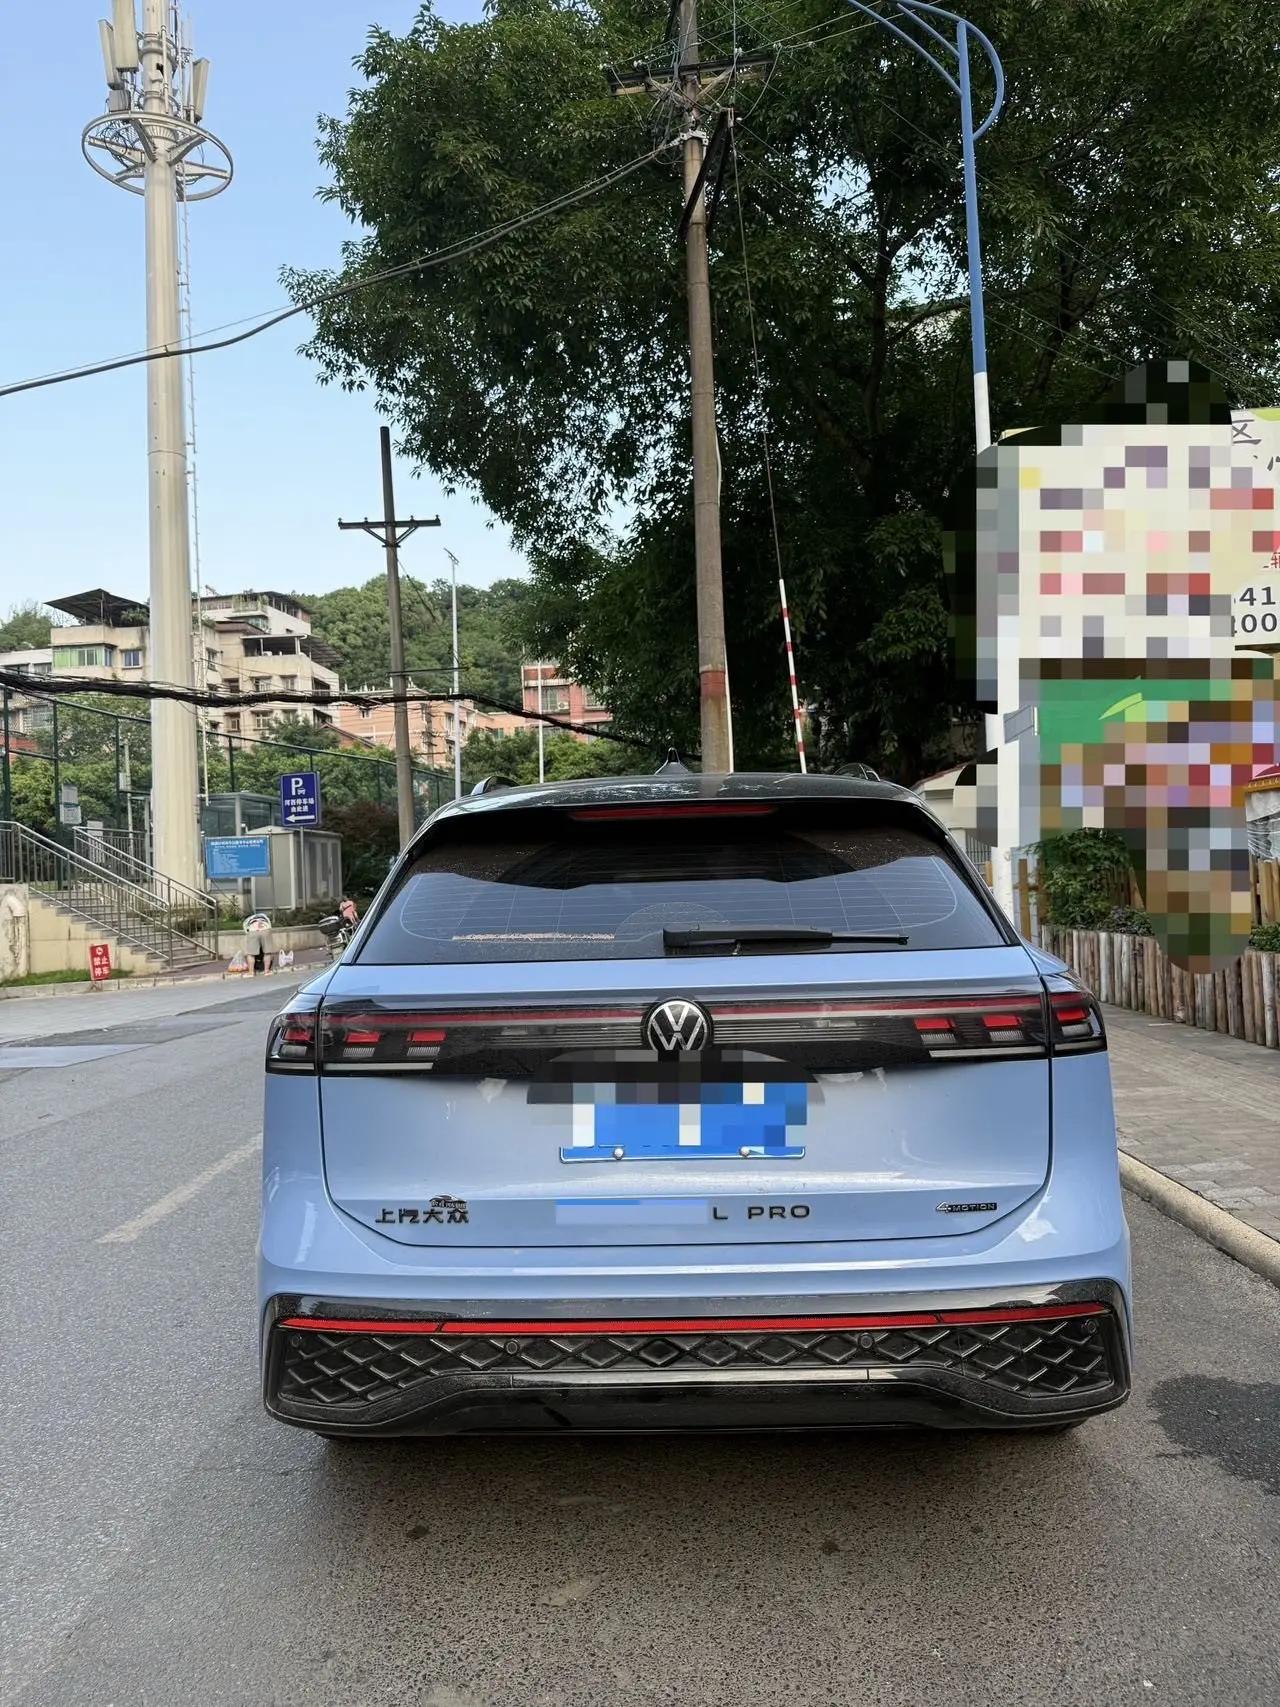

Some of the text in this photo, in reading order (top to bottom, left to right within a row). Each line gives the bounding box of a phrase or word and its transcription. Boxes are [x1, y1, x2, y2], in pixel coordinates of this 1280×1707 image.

[1233, 586, 1277, 606] 41
[291, 777, 303, 796] P
[93, 956, 109, 966] 禁止
[94, 966, 110, 977] 停车
[712, 1205, 811, 1220] L PRO
[936, 1201, 997, 1213] 4MOTION
[375, 1208, 469, 1224] 上汽大众
